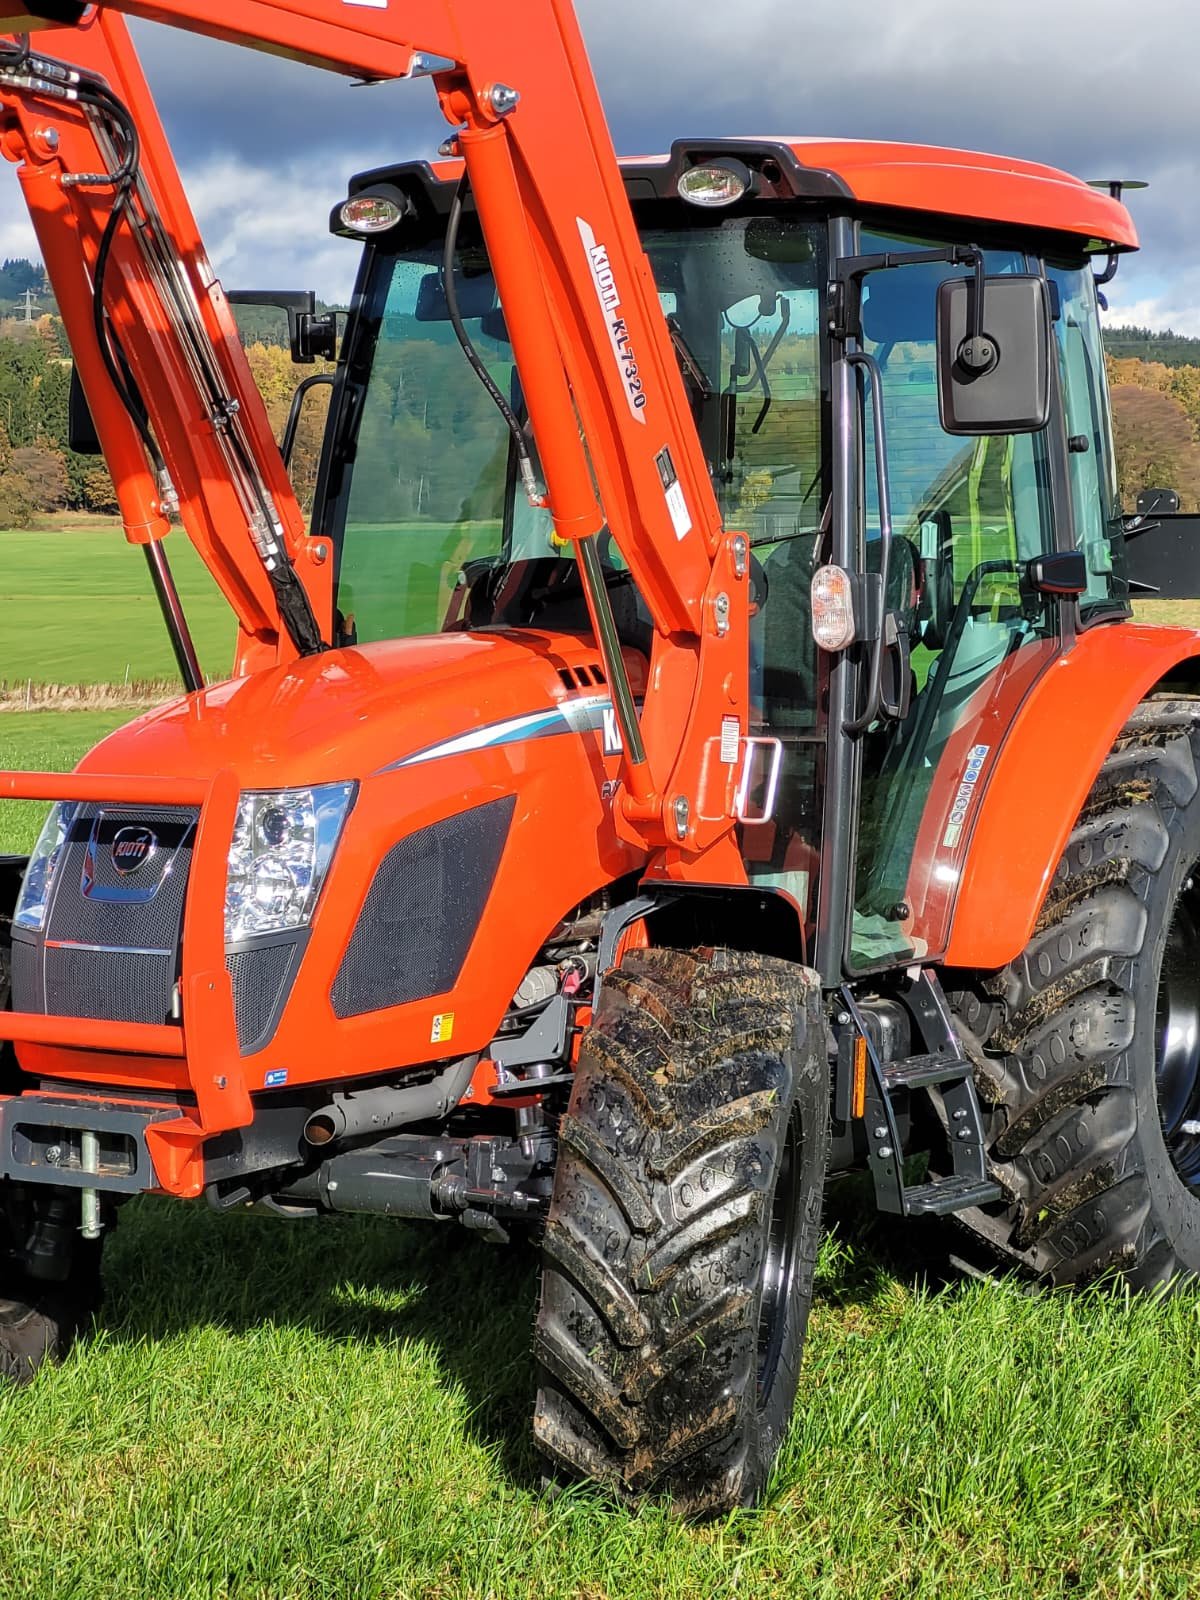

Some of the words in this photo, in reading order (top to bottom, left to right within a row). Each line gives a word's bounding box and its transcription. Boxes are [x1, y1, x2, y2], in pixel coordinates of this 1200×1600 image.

[590, 243, 622, 312] KIOTI
[612, 319, 646, 408] KL7320
[114, 841, 146, 857] KIOTI
